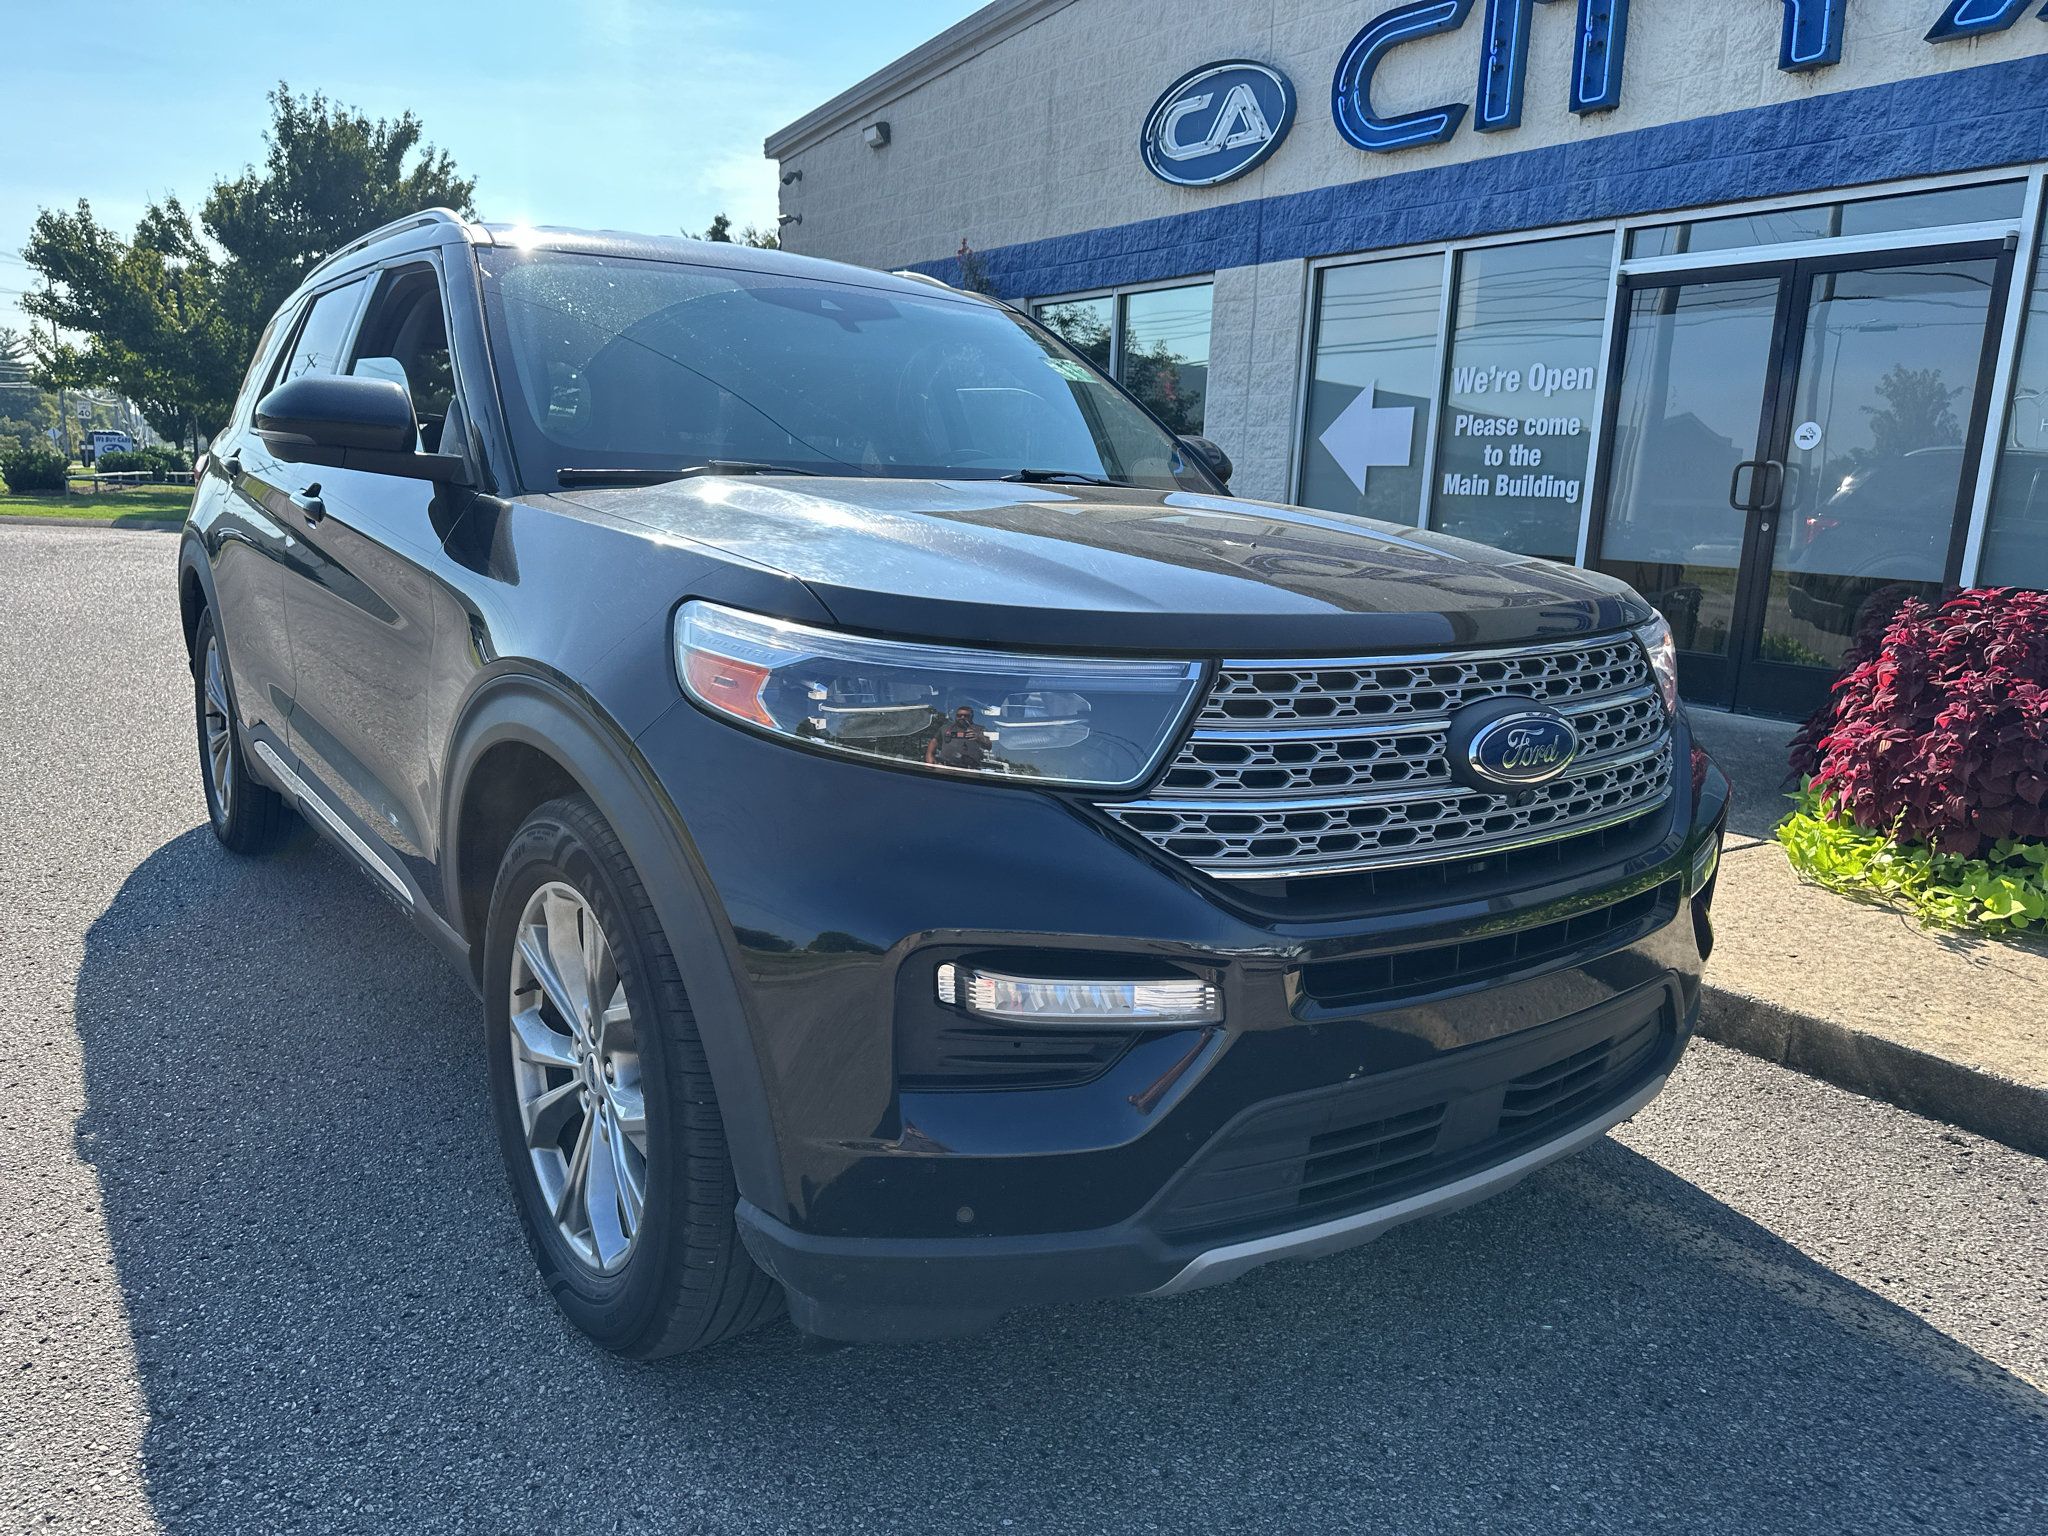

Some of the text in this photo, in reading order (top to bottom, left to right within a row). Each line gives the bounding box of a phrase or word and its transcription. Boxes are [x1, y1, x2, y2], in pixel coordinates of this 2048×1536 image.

[1158, 83, 1272, 161] CA
[1453, 362, 1594, 397] We're Open
[1454, 414, 1581, 437] Please come
[1483, 443, 1542, 466] to the
[1442, 473, 1580, 504] Main Building
[1502, 727, 1560, 769] Ford
